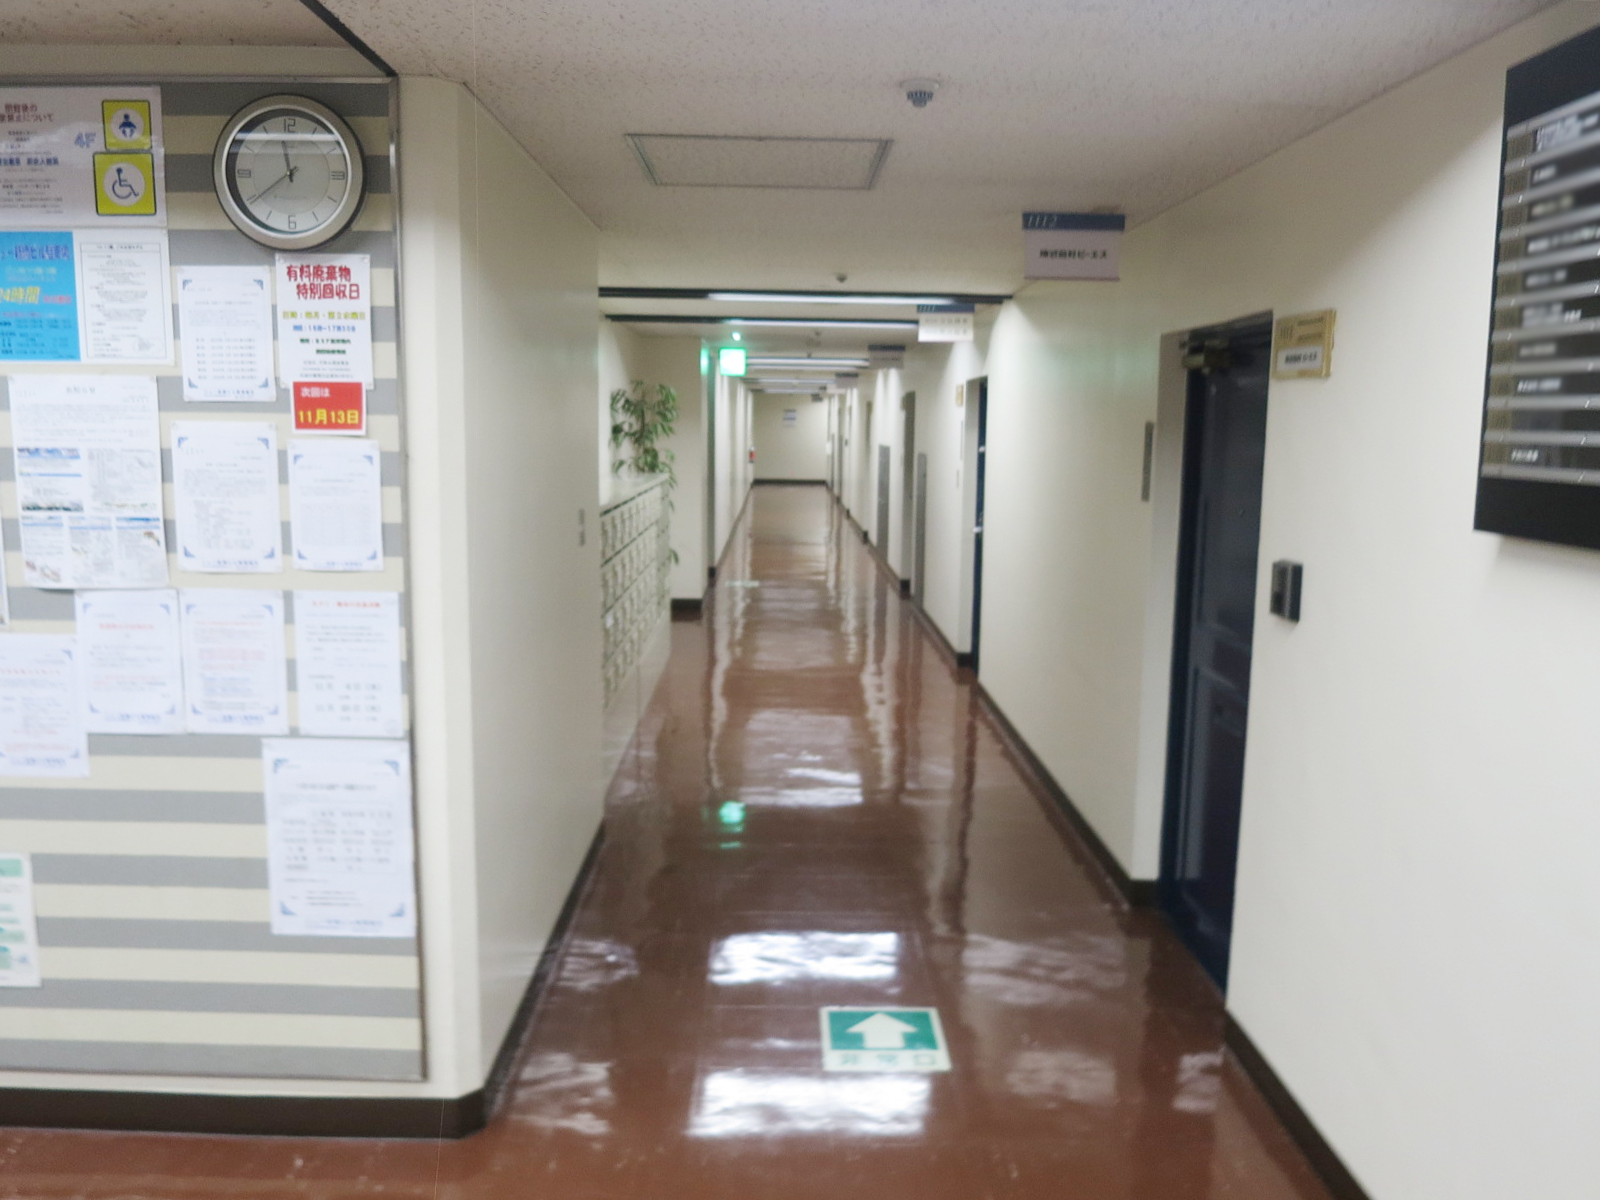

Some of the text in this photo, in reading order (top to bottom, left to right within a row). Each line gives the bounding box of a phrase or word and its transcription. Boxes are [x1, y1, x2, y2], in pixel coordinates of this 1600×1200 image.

[283, 118, 296, 133] 12
[288, 215, 297, 230] 6
[287, 264, 351, 282] 有料廃棄物
[296, 283, 360, 300] 特別回収日
[301, 386, 330, 398] 次回は
[299, 408, 359, 425] 11月13日
